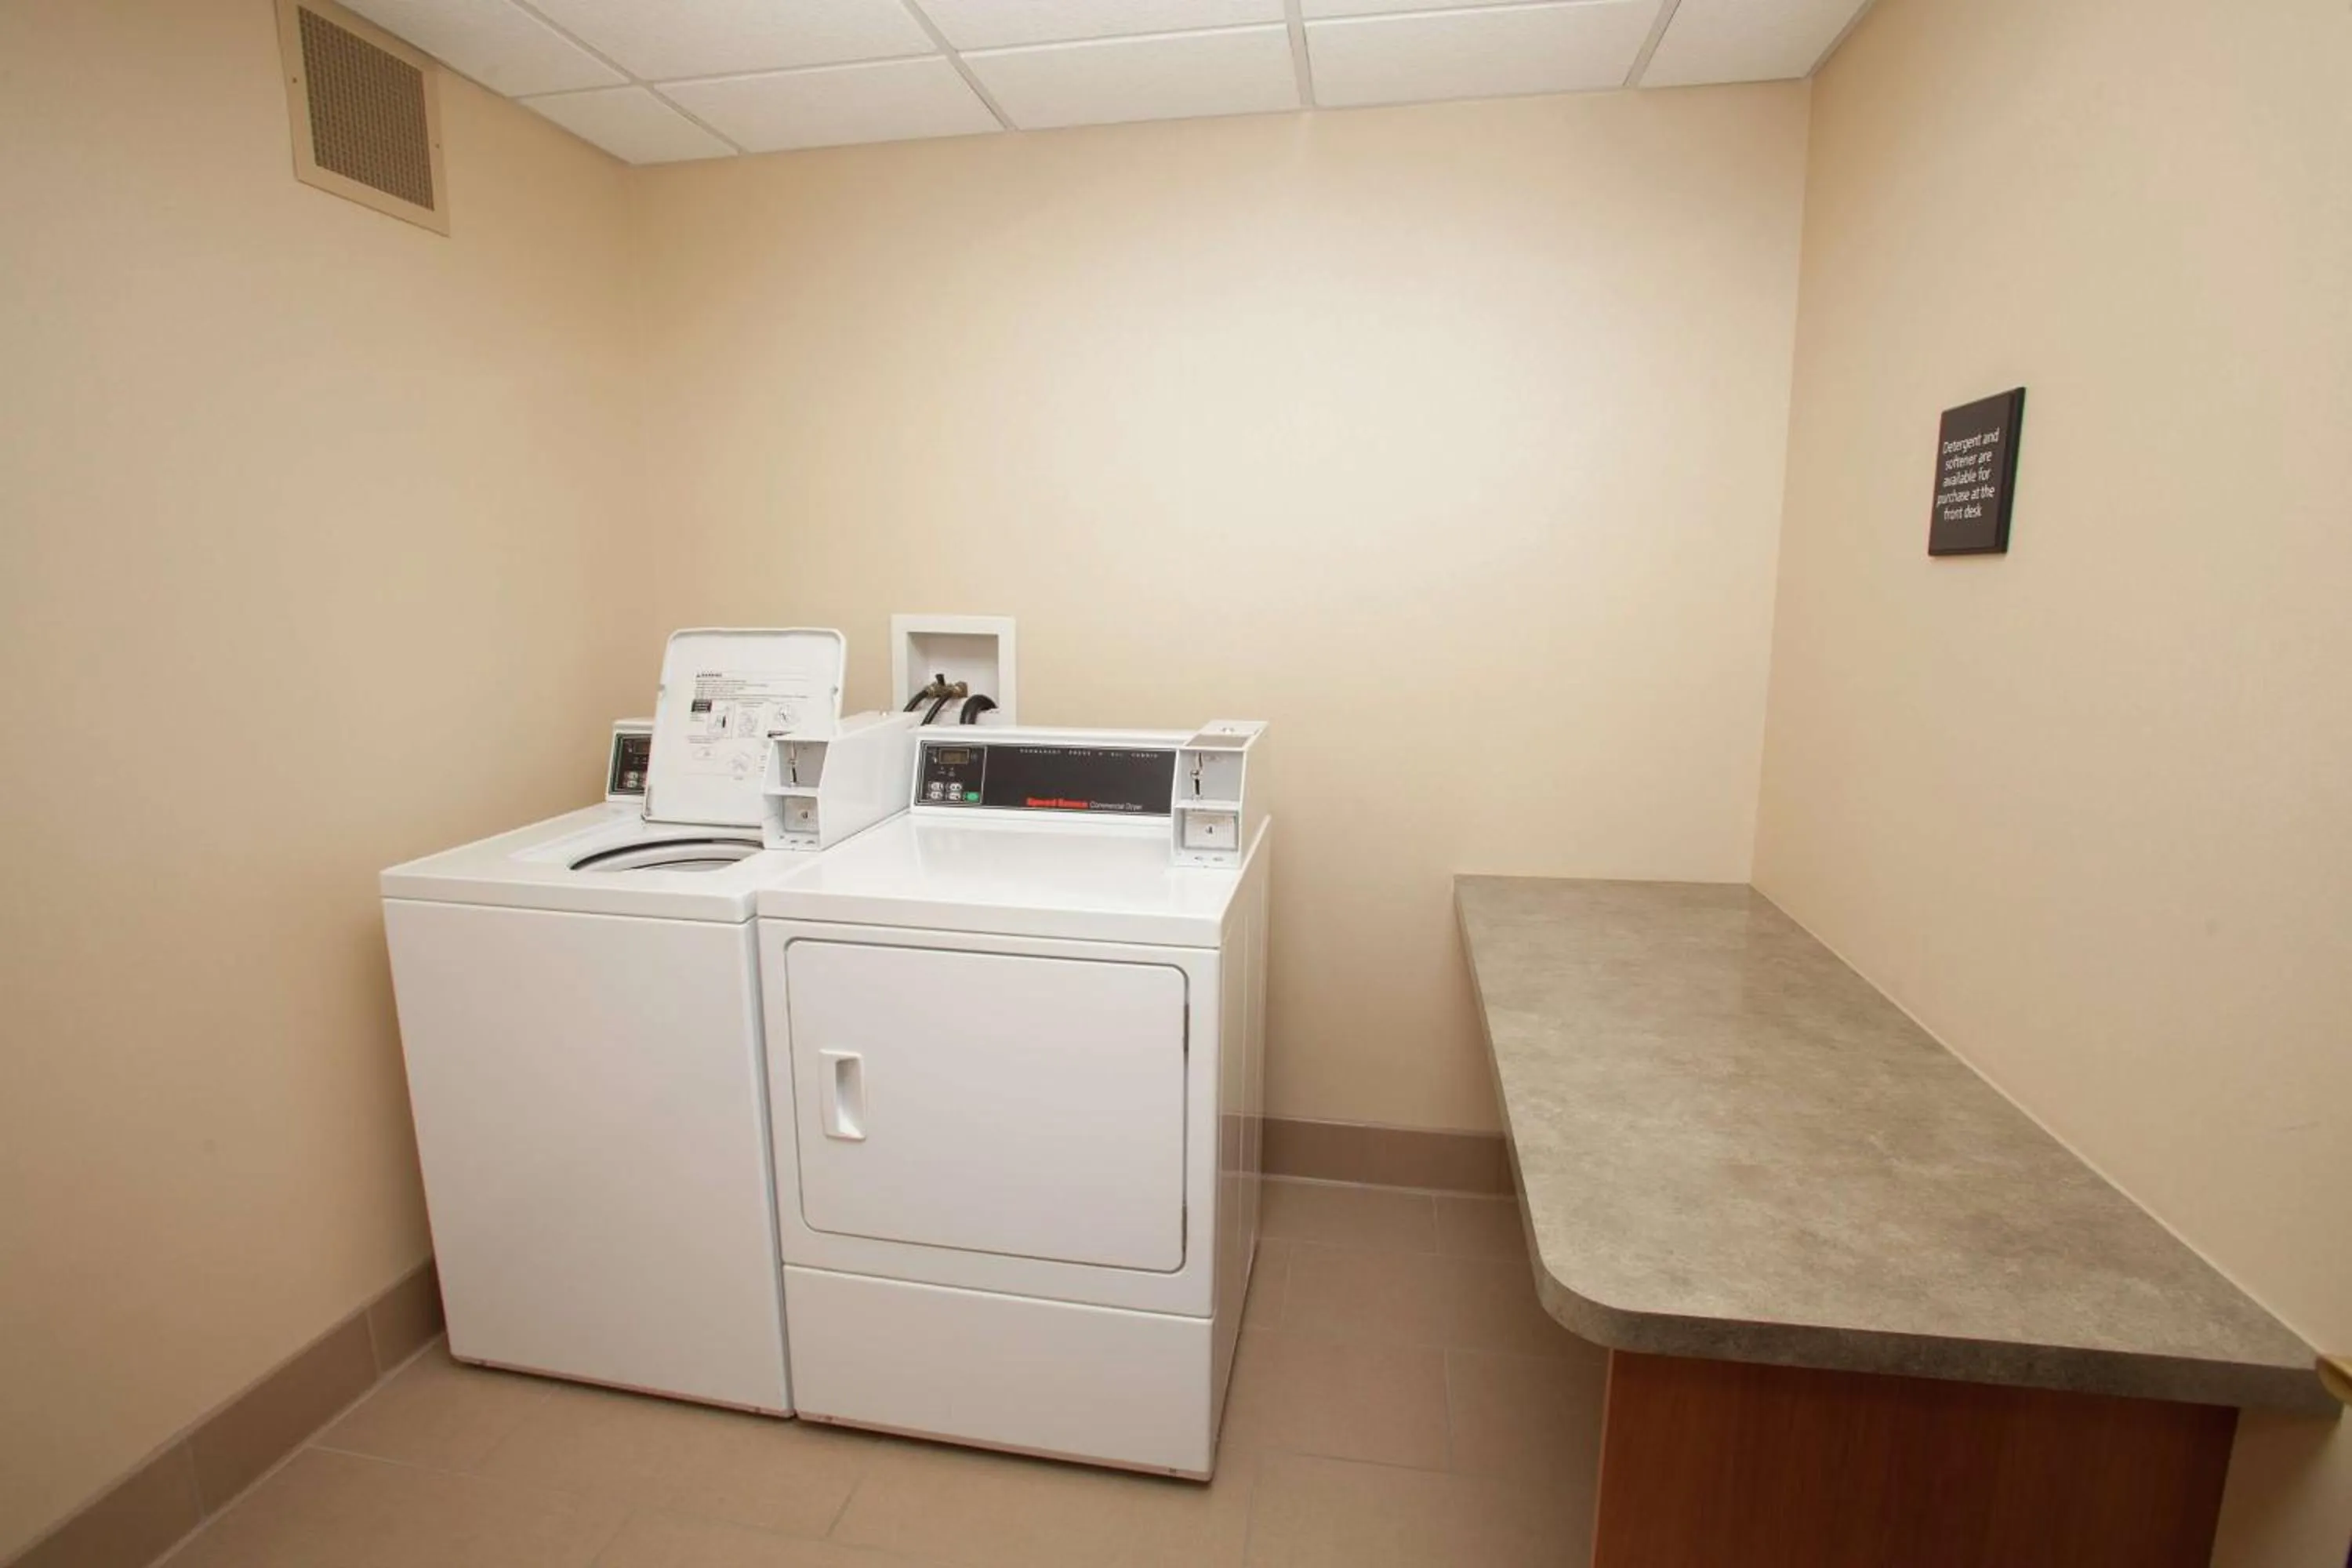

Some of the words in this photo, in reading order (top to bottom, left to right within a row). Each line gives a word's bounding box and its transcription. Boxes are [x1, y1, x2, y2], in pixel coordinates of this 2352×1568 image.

[1944, 434, 1982, 454] Detergent
[1983, 426, 2000, 445] and
[1945, 455, 1977, 470] softener
[1979, 451, 1993, 463] are
[1943, 470, 1976, 487] available
[1978, 467, 1991, 481] for
[1936, 489, 1970, 508] purchase
[1971, 488, 1980, 499] at
[1980, 484, 1995, 499] the
[1944, 507, 1963, 521] front
[1964, 503, 1982, 518] desk
[1126, 802, 1143, 811] Dryer
